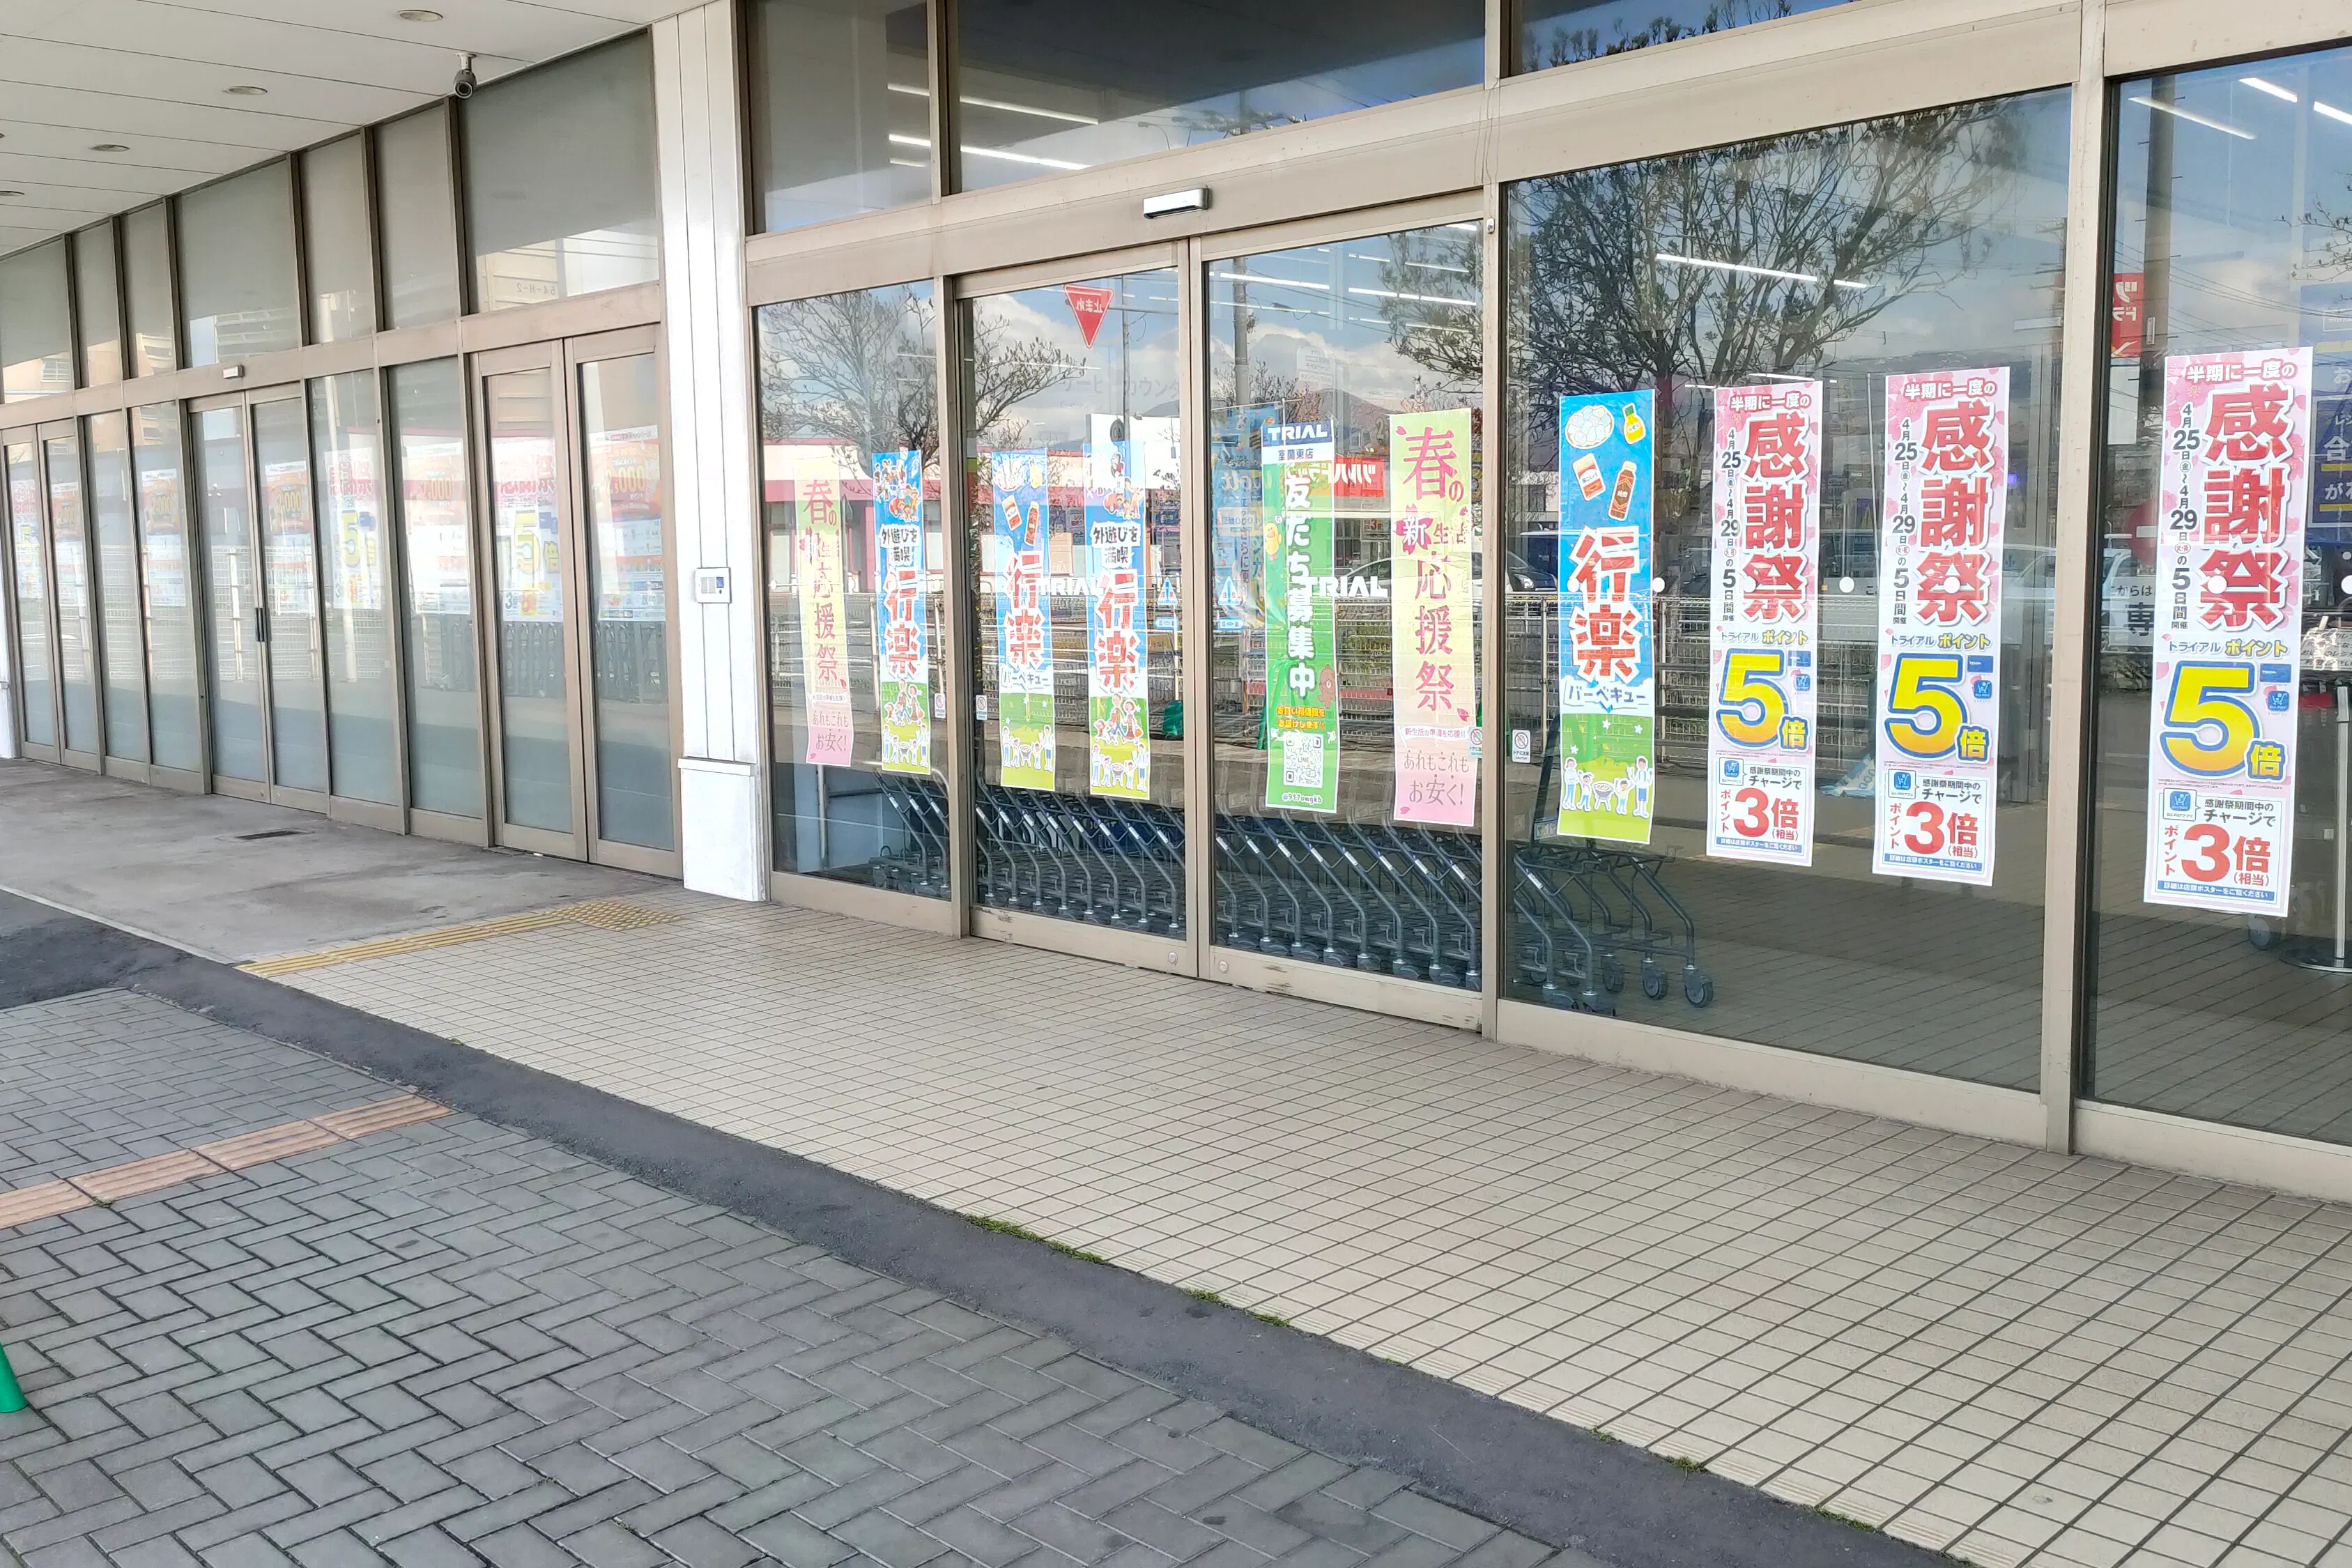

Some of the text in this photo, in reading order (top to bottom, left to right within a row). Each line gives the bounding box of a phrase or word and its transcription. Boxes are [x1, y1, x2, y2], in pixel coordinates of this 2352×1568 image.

[2186, 358, 2297, 383] 半期に一度の
[1904, 377, 1997, 401] 半期に一度の
[1730, 391, 1811, 413] 半期に一度の
[1268, 424, 1328, 441] TRIAL
[1403, 426, 1463, 502] 春の
[1742, 410, 1806, 620] 感謝祭
[1917, 399, 1990, 622] 感謝祭
[2199, 382, 2288, 627] 感謝祭
[1093, 526, 1138, 544] 外遊びを
[1292, 576, 1388, 597] TRIAL
[1572, 529, 1640, 679] 行楽
[1569, 685, 1646, 703] バーベキュー
[1404, 751, 1470, 774] あれもこれも
[1748, 775, 1802, 790] チャージで
[1922, 789, 1982, 804] チャージで
[2205, 799, 2274, 811] 感謝祭期間中の
[1890, 803, 1901, 850] ポイント
[2204, 809, 2276, 827] チャージで
[2165, 825, 2178, 876] ポイント
